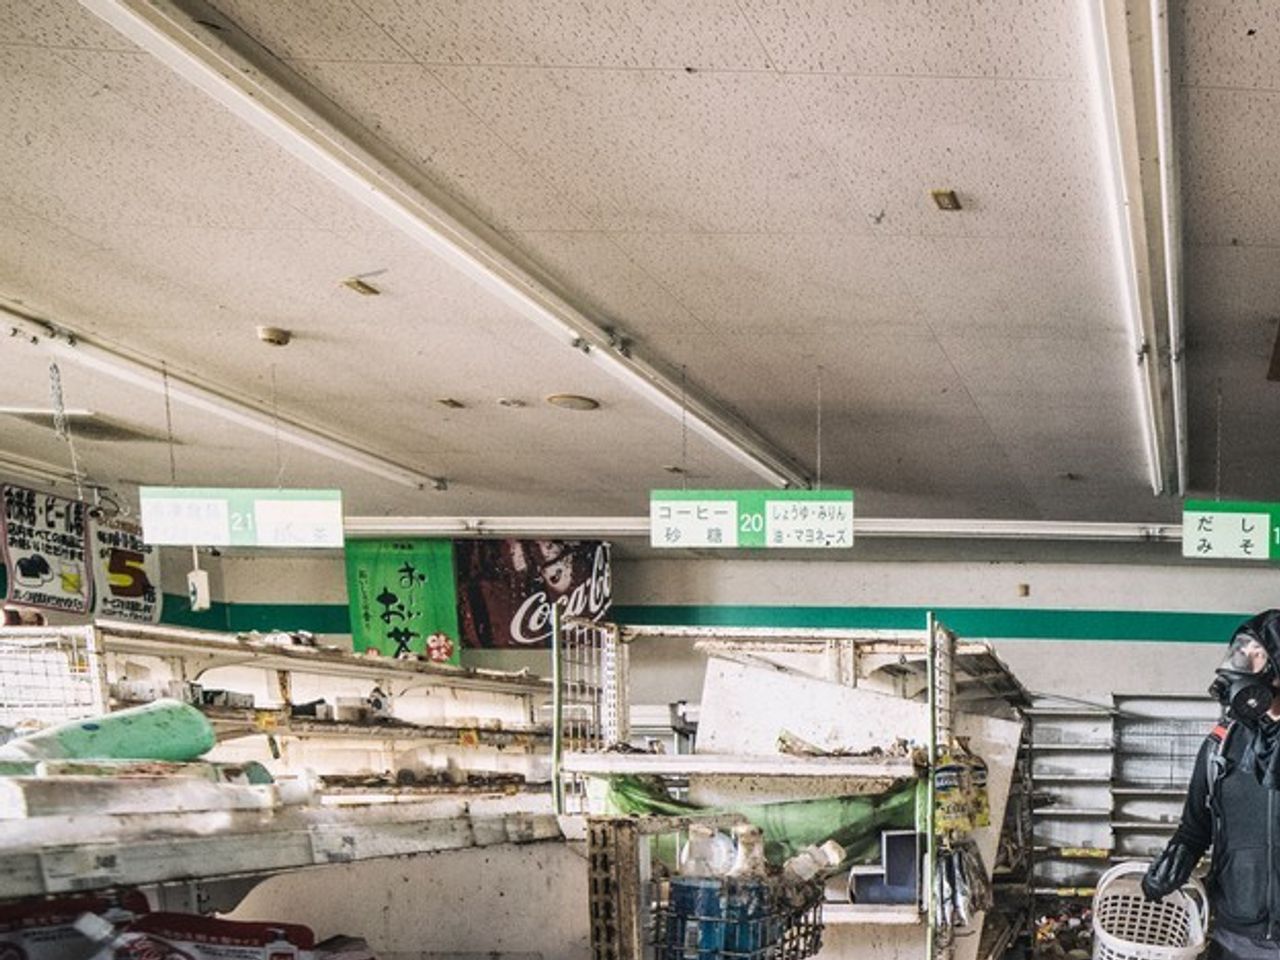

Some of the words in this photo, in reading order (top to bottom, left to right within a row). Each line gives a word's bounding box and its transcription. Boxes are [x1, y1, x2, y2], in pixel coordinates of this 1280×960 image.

[658, 505, 729, 520] コーヒー
[772, 504, 847, 521] しょうゆ・みりん
[231, 512, 254, 532] 21
[739, 513, 764, 532] 20
[1197, 515, 1255, 533] だし
[664, 526, 724, 544] 砂糖
[1196, 538, 1255, 555] みそ
